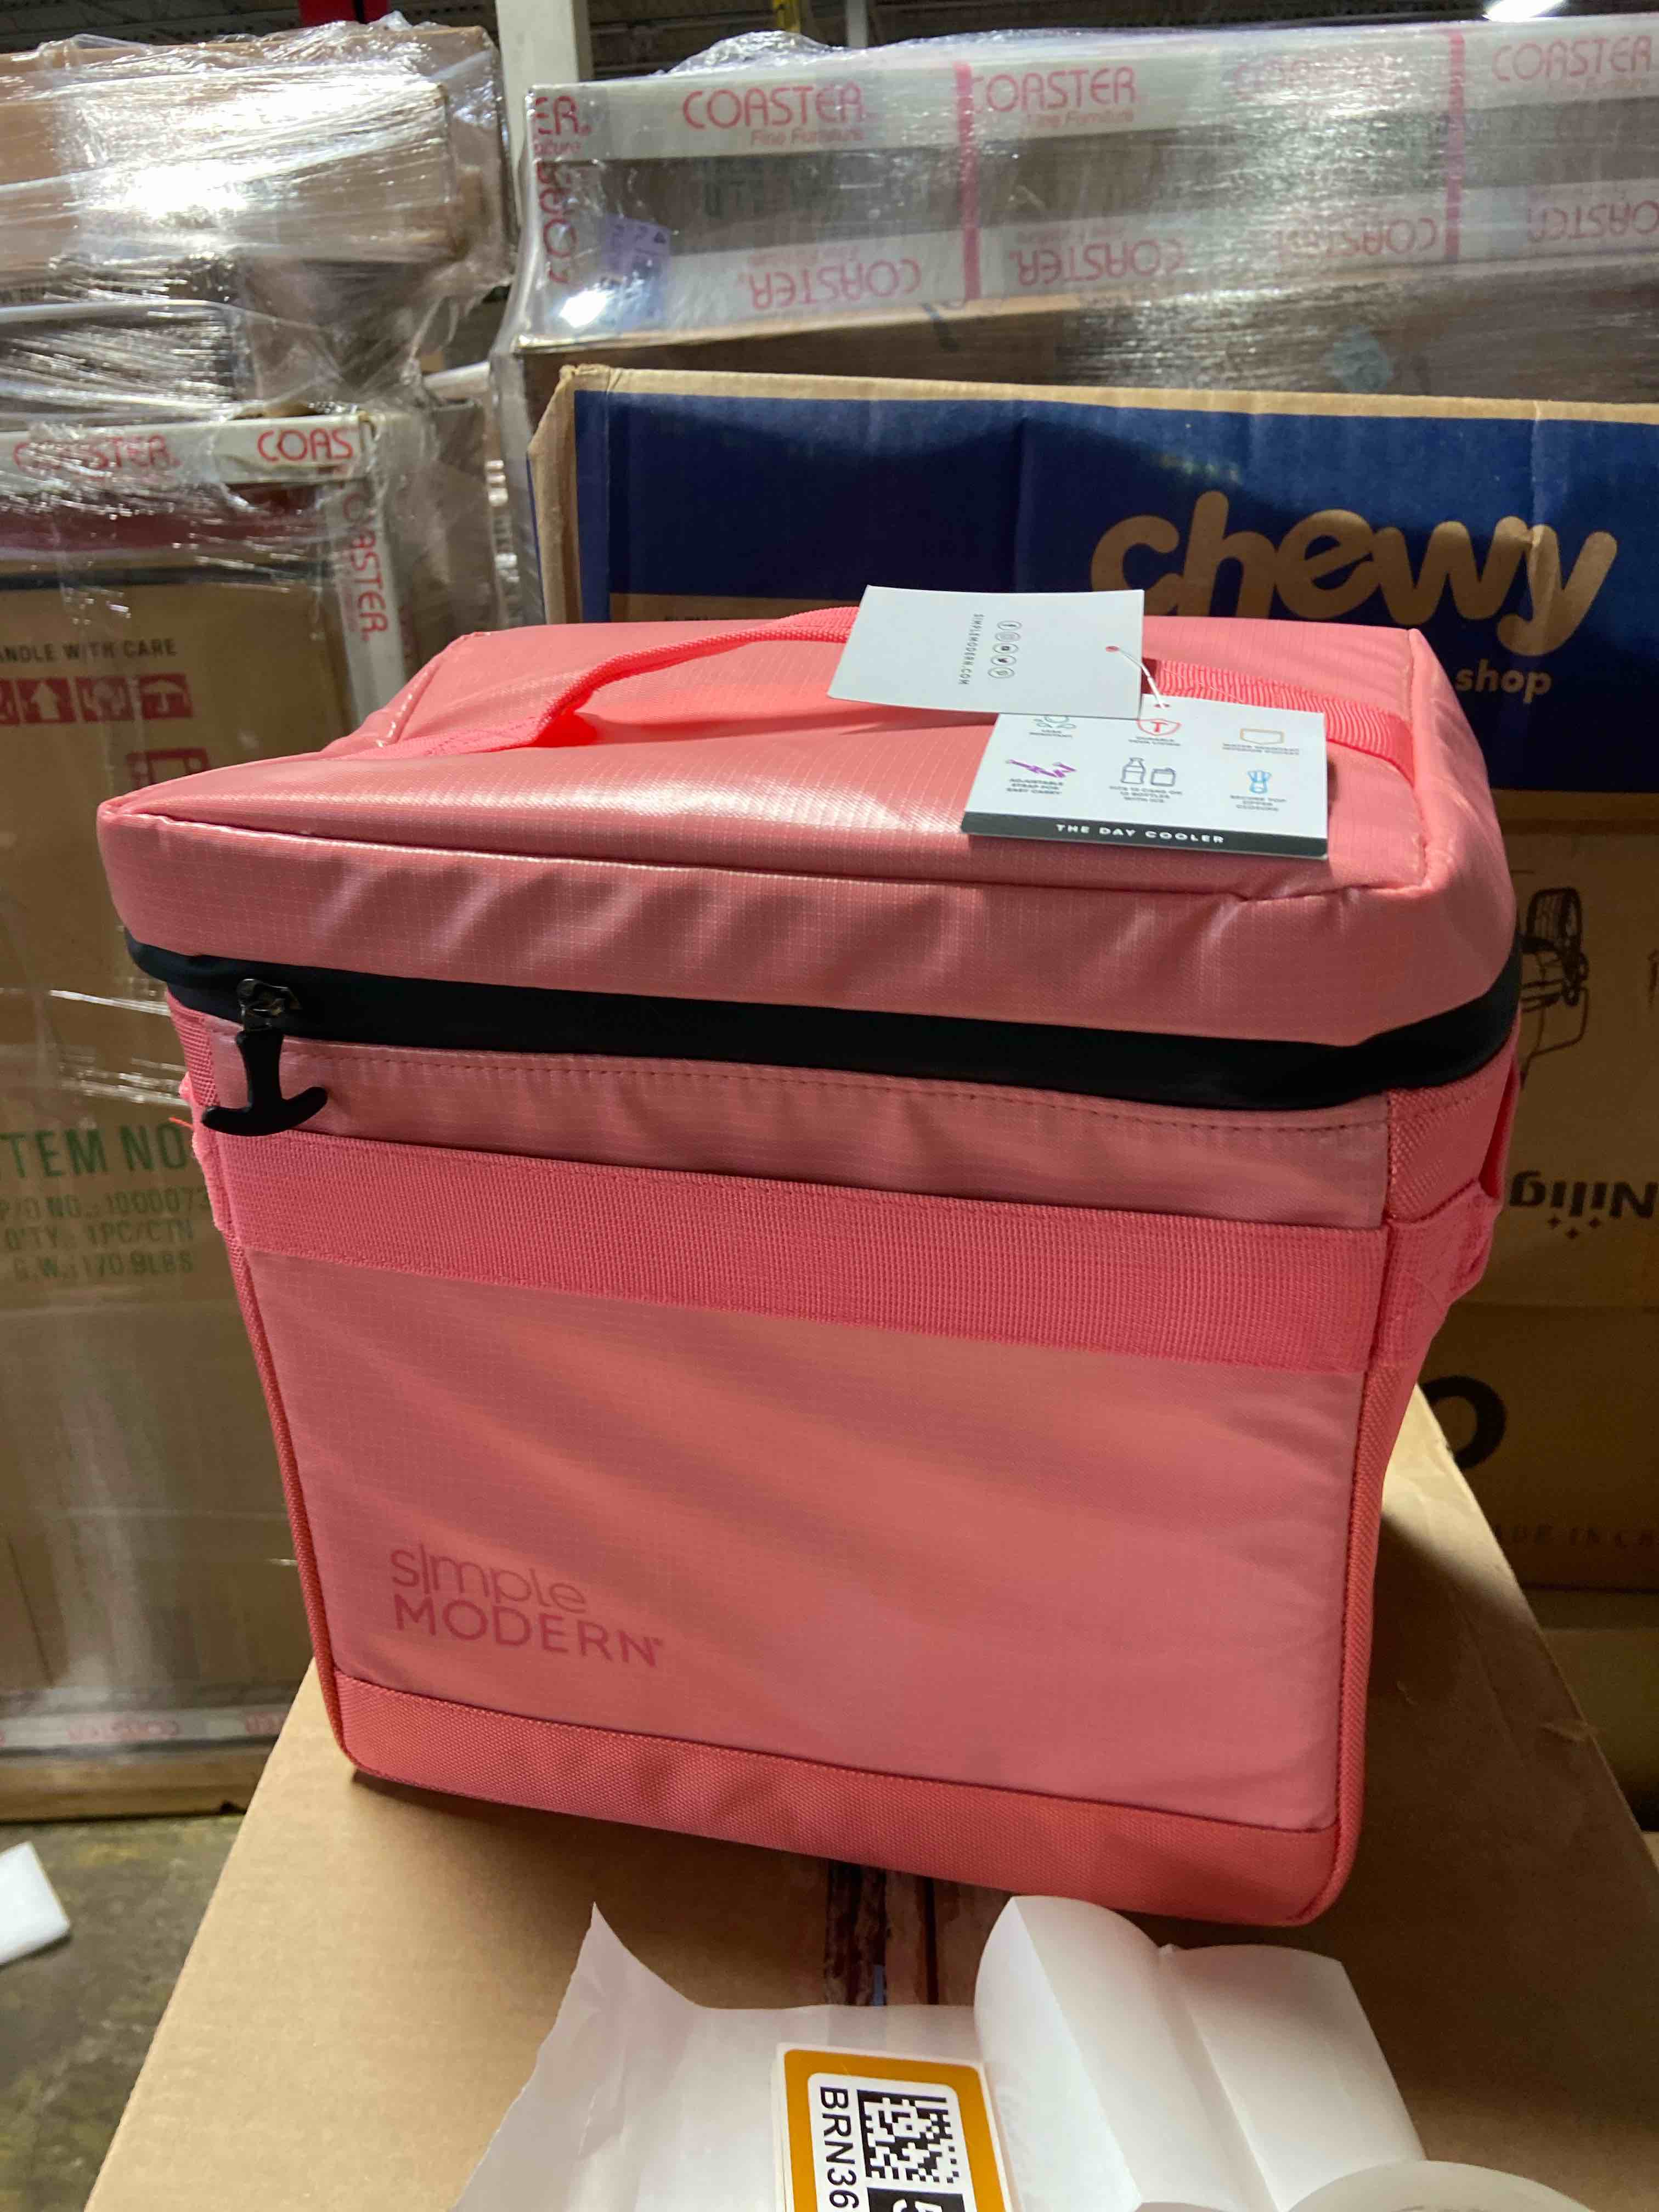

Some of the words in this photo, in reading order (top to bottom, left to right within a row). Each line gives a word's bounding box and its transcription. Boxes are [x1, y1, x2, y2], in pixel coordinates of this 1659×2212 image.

[682, 81, 864, 130] COASTER
[748, 258, 921, 311] COASTER
[13, 435, 171, 471] CSTER
[257, 430, 354, 463] COAS
[1091, 491, 1617, 656] chewy
[62, 641, 115, 660] WITH
[123, 638, 179, 657] CARE
[1457, 659, 1552, 703] shop
[1056, 823, 1091, 834] THE
[1099, 826, 1137, 839] DAY
[1144, 830, 1225, 844] COOLER
[0, 1128, 109, 1178] TEM
[118, 1122, 188, 1172] NO
[390, 1544, 586, 1614] simple
[393, 1594, 658, 1668] MODERN
[819, 2086, 860, 2208] BRN36
